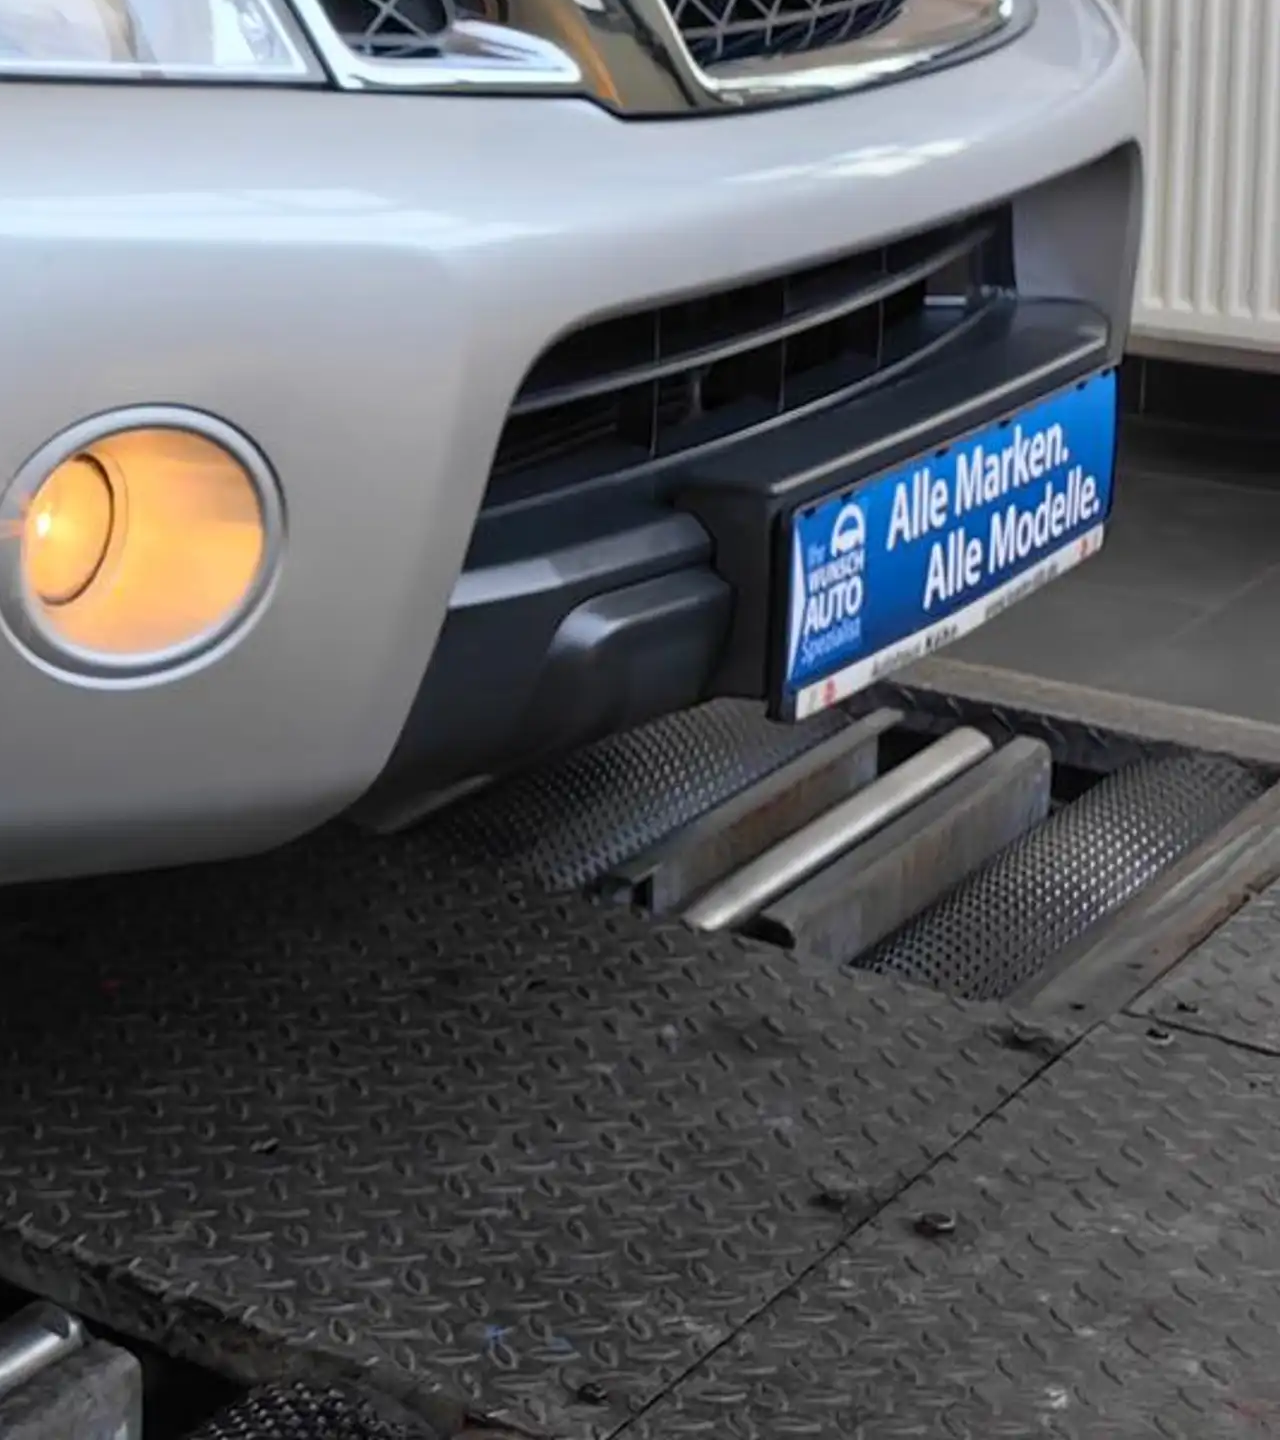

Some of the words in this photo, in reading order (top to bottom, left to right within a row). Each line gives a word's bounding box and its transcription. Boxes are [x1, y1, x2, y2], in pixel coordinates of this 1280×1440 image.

[886, 467, 949, 551] Alle
[954, 422, 1069, 517] Marken.
[922, 527, 981, 610] Alle
[988, 465, 1100, 574] Modelle.
[804, 575, 864, 635] AUTO
